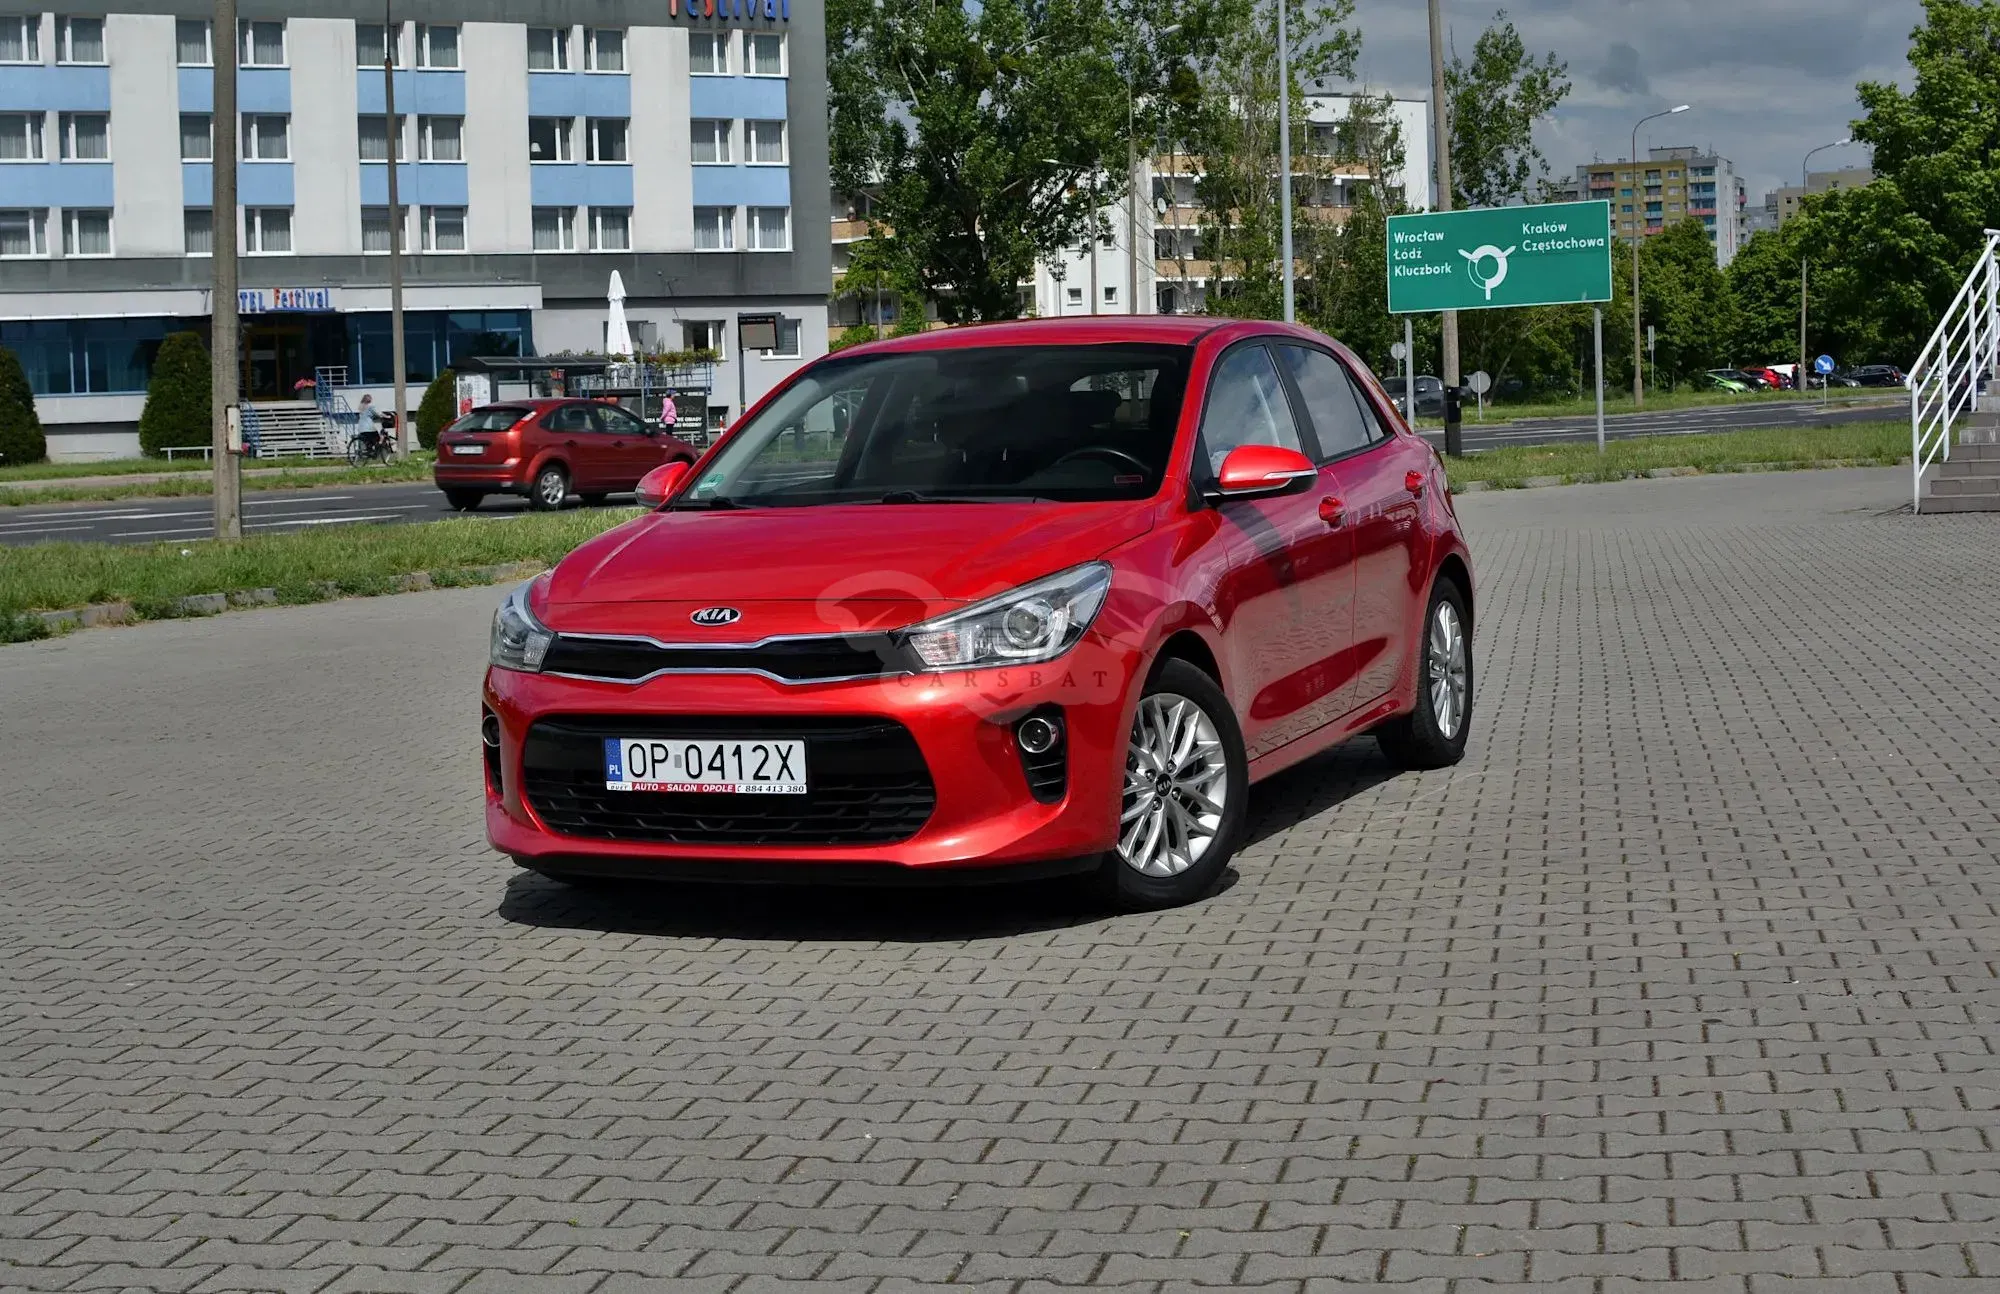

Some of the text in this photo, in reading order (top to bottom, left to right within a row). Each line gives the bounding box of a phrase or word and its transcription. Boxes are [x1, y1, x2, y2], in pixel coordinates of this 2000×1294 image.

[1522, 221, 1568, 235] Kraków
[1394, 230, 1445, 244] Wrocław
[1522, 236, 1605, 253] Częstochowa
[1393, 246, 1423, 261] Łódź
[1394, 262, 1452, 277] Kluczbork
[239, 288, 330, 312] TEL Festival
[696, 608, 731, 621] KIA
[628, 743, 796, 781] OP 0412X
[609, 764, 621, 775] PL
[634, 783, 659, 791] AUTO
[666, 784, 698, 792] SALON
[702, 785, 733, 793] OPOLE
[745, 785, 763, 793] 884
[766, 785, 784, 793] 413
[786, 785, 805, 793] 380
[1157, 781, 1173, 792] KIA
